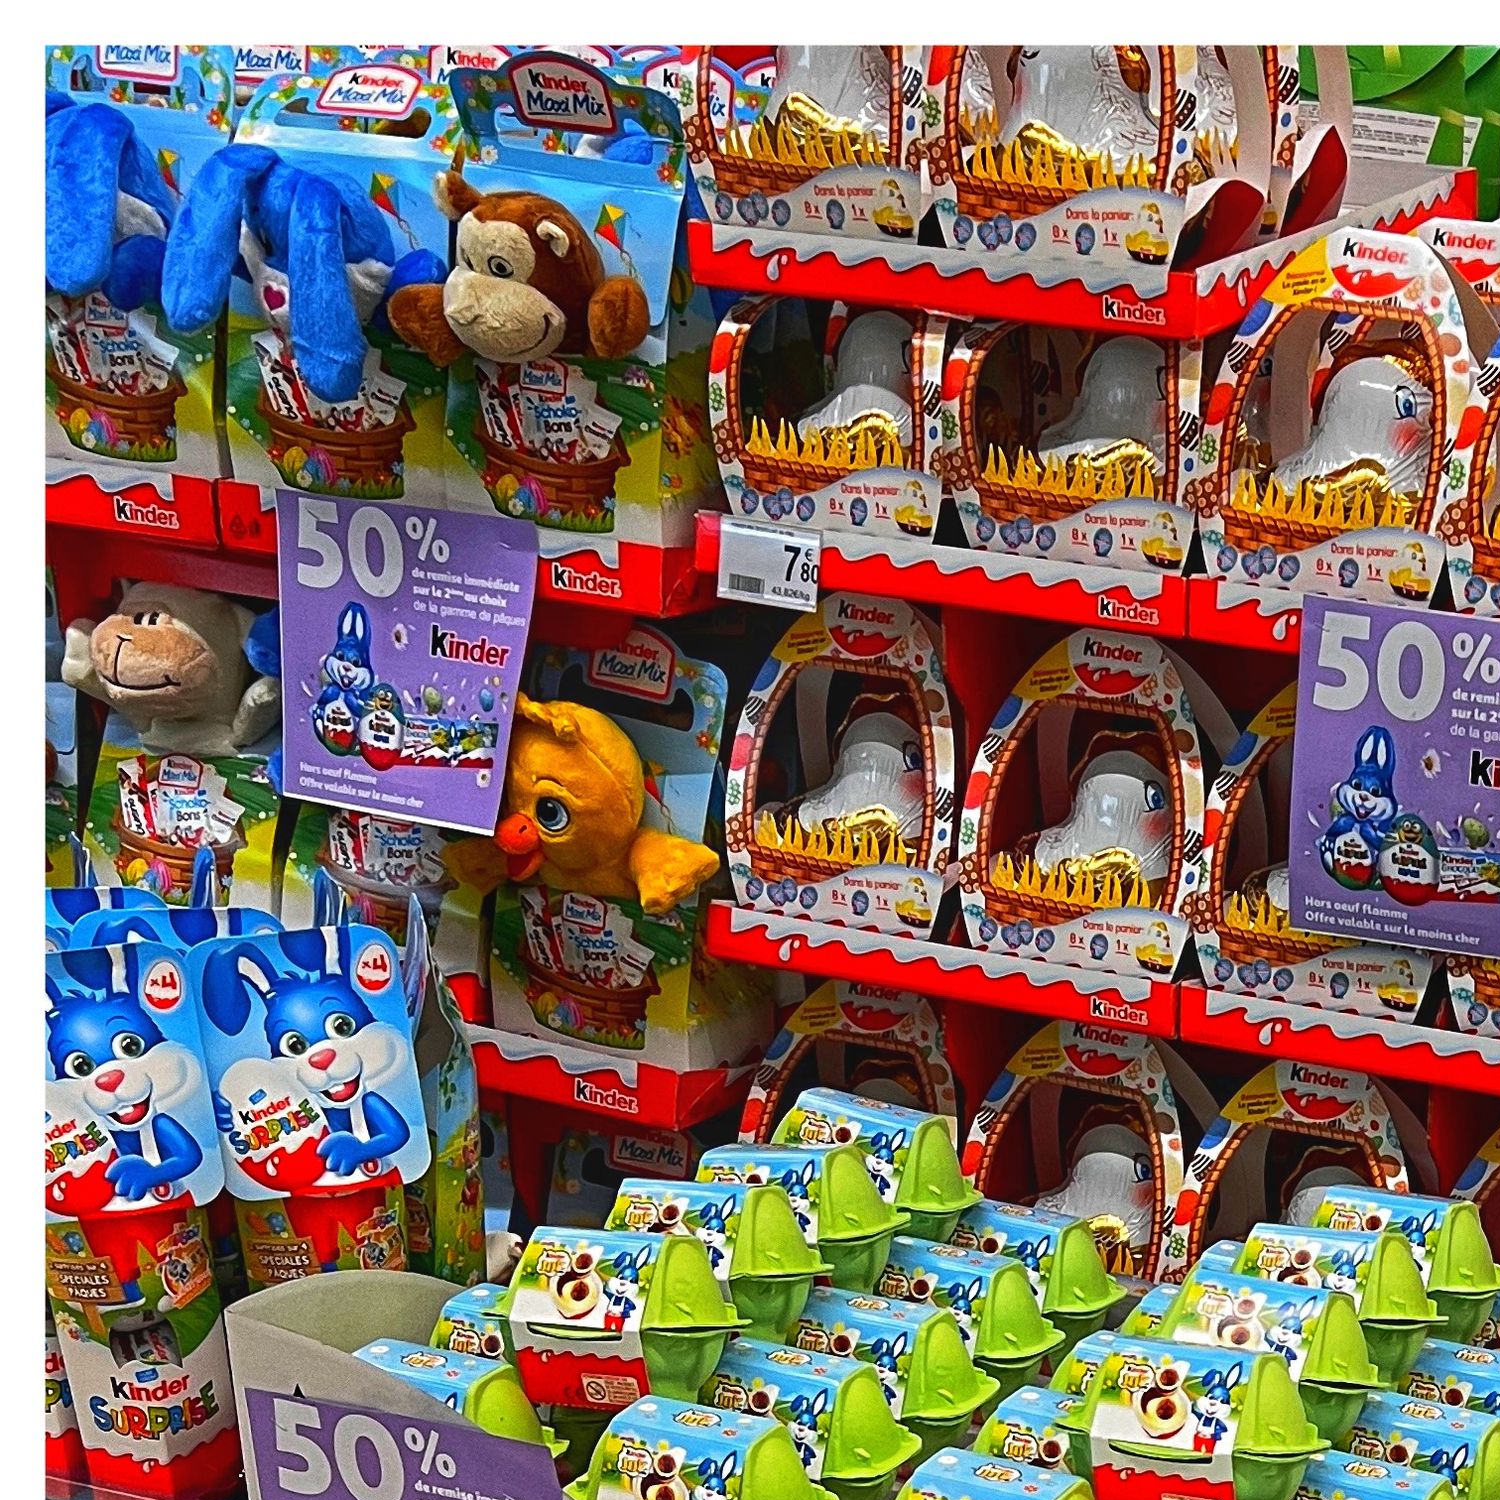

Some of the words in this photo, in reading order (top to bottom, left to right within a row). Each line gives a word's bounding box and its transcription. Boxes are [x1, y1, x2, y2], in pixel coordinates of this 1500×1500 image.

[528, 69, 590, 92] Kinder
[527, 91, 571, 114] Maxi
[572, 93, 606, 116] Mix
[1343, 237, 1409, 263] Kinder
[1104, 298, 1163, 323] Kinder
[116, 498, 178, 529] Kinder
[297, 497, 450, 598] 50%
[554, 565, 622, 596] Kinder
[431, 623, 510, 667] Kinder
[1084, 637, 1142, 663] Kinder
[1451, 687, 1469, 701] de
[1093, 998, 1147, 1024] Kinder
[239, 1095, 291, 1125] Kinder
[228, 1099, 320, 1154] SURPRISE
[109, 1374, 191, 1402] Kinder
[89, 1380, 220, 1440] SURPRISE
